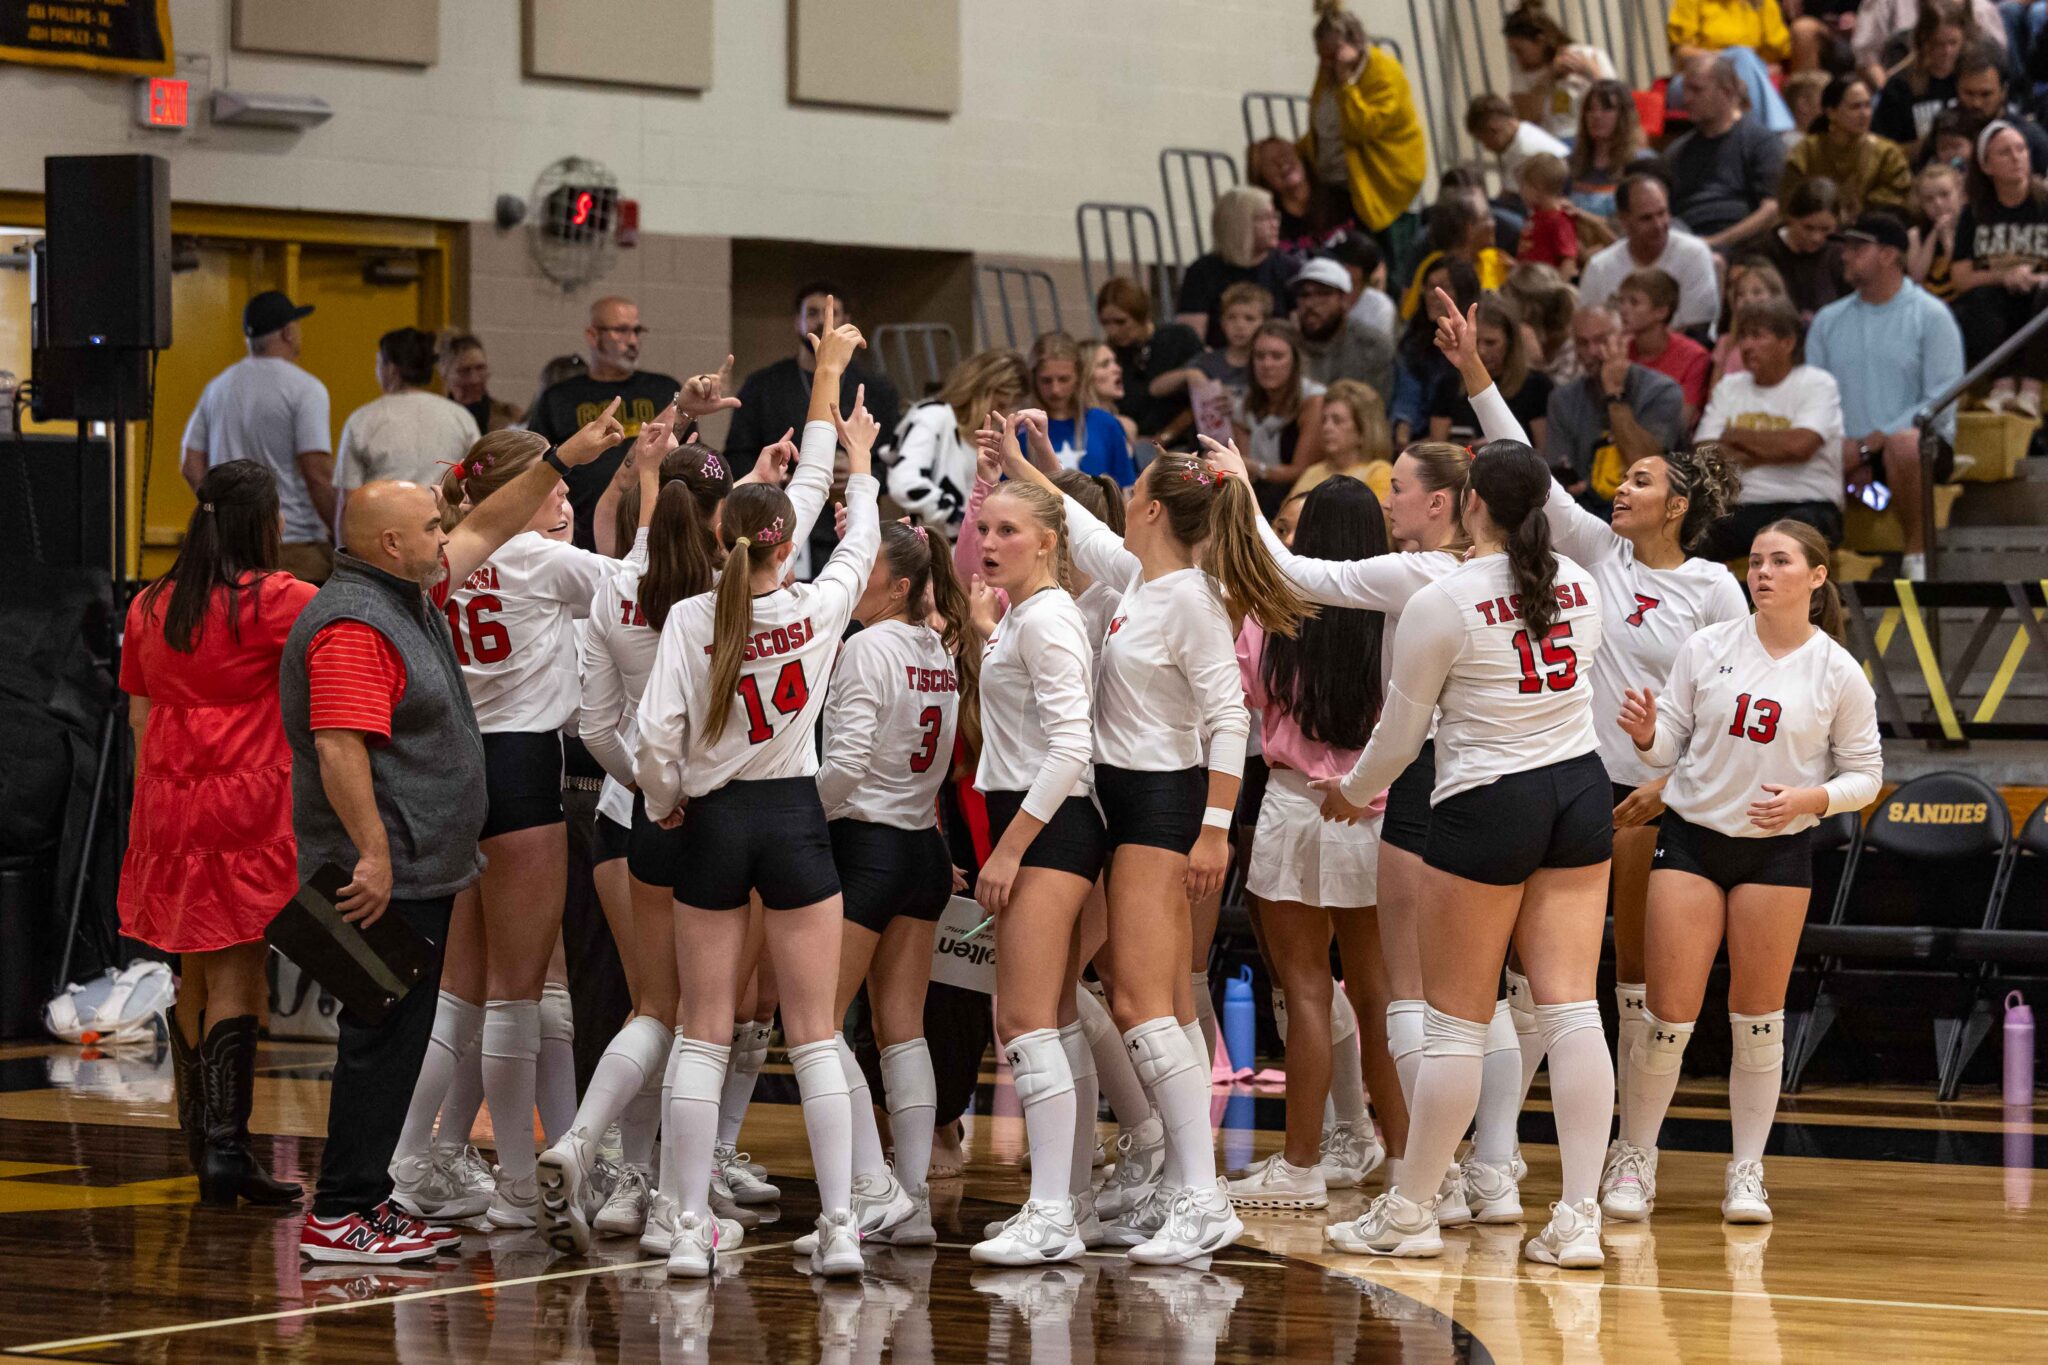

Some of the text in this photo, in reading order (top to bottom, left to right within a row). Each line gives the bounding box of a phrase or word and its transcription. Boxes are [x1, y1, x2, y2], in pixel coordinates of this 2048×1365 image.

[151, 78, 187, 126] EXIT
[446, 593, 512, 665] 16
[1475, 582, 1588, 626] TASSA
[1625, 593, 1660, 627] 7
[1511, 621, 1578, 694] 15
[736, 659, 809, 745] 14
[1729, 692, 1782, 744] 13
[909, 705, 942, 773] 3
[1888, 802, 1988, 823] SANDIES
[938, 937, 996, 965] olten
